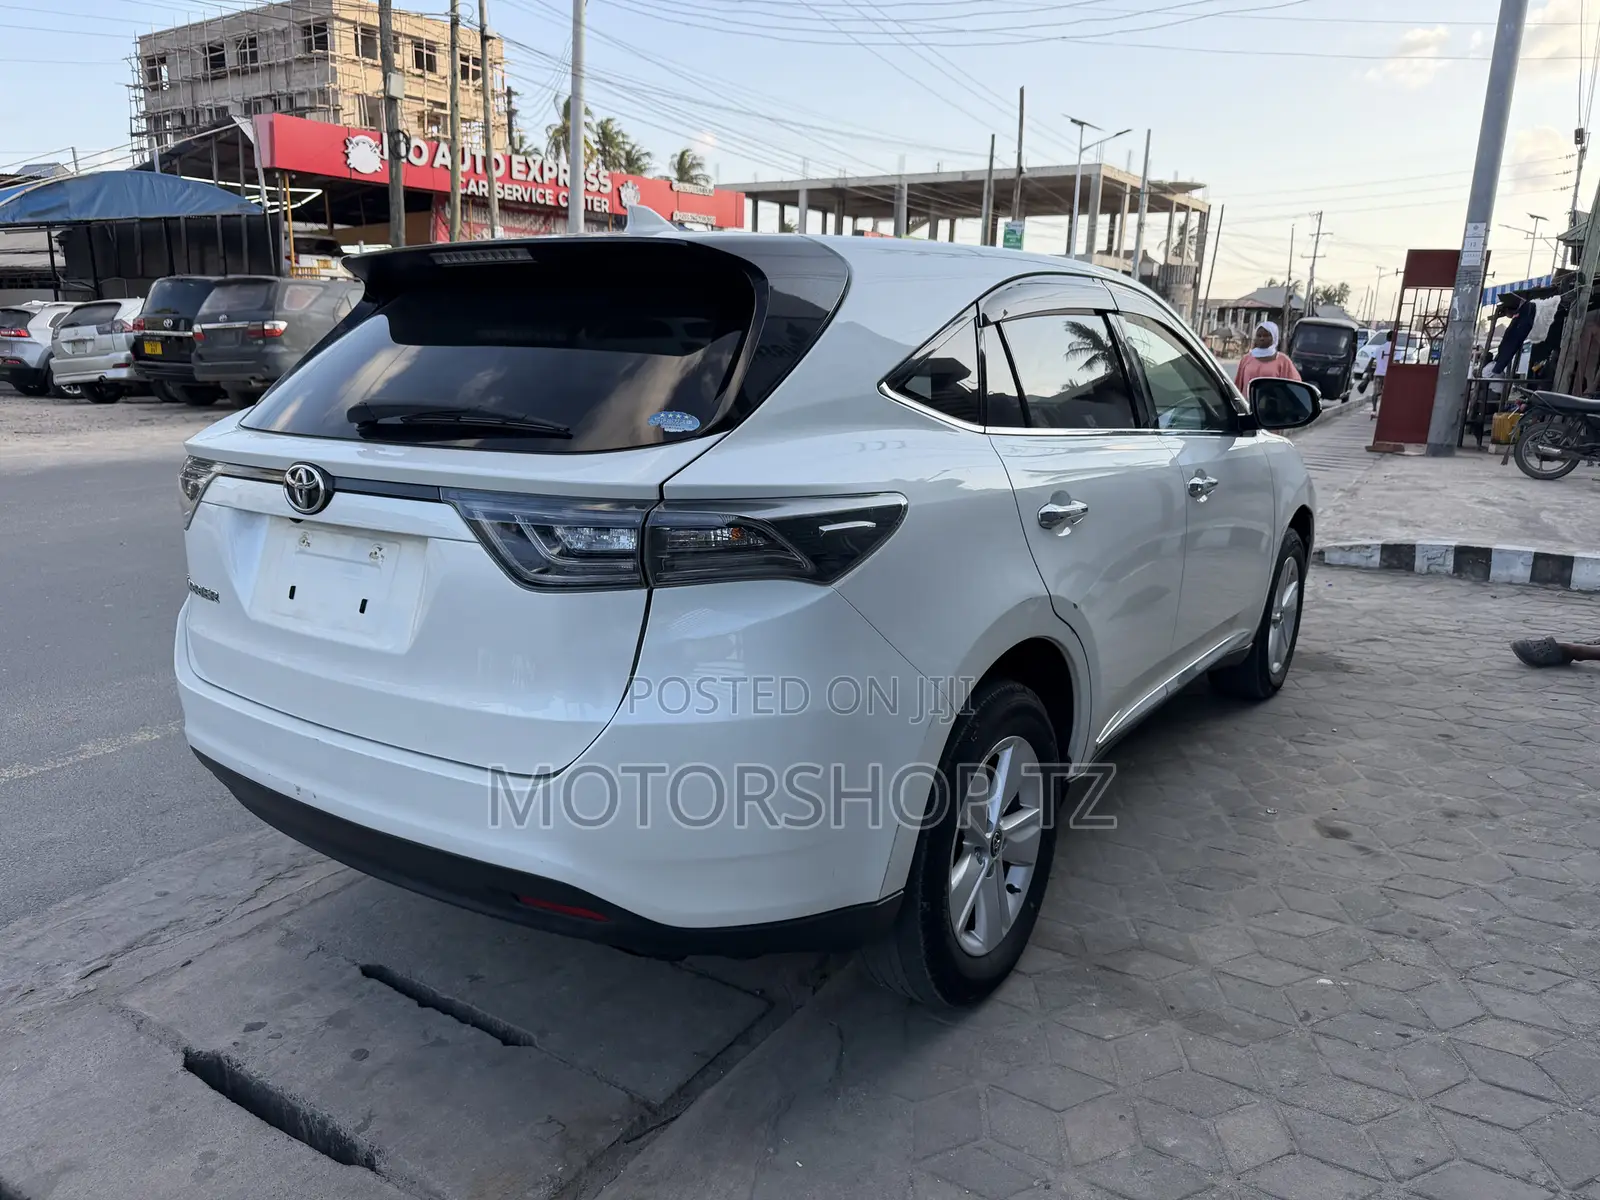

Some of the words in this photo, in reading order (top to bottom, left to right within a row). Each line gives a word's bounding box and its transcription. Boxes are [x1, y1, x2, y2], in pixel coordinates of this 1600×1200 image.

[431, 140, 506, 178] AUTO
[510, 153, 613, 194] EXPRSS
[494, 181, 555, 206] SERVICE
[558, 190, 610, 214] CTER
